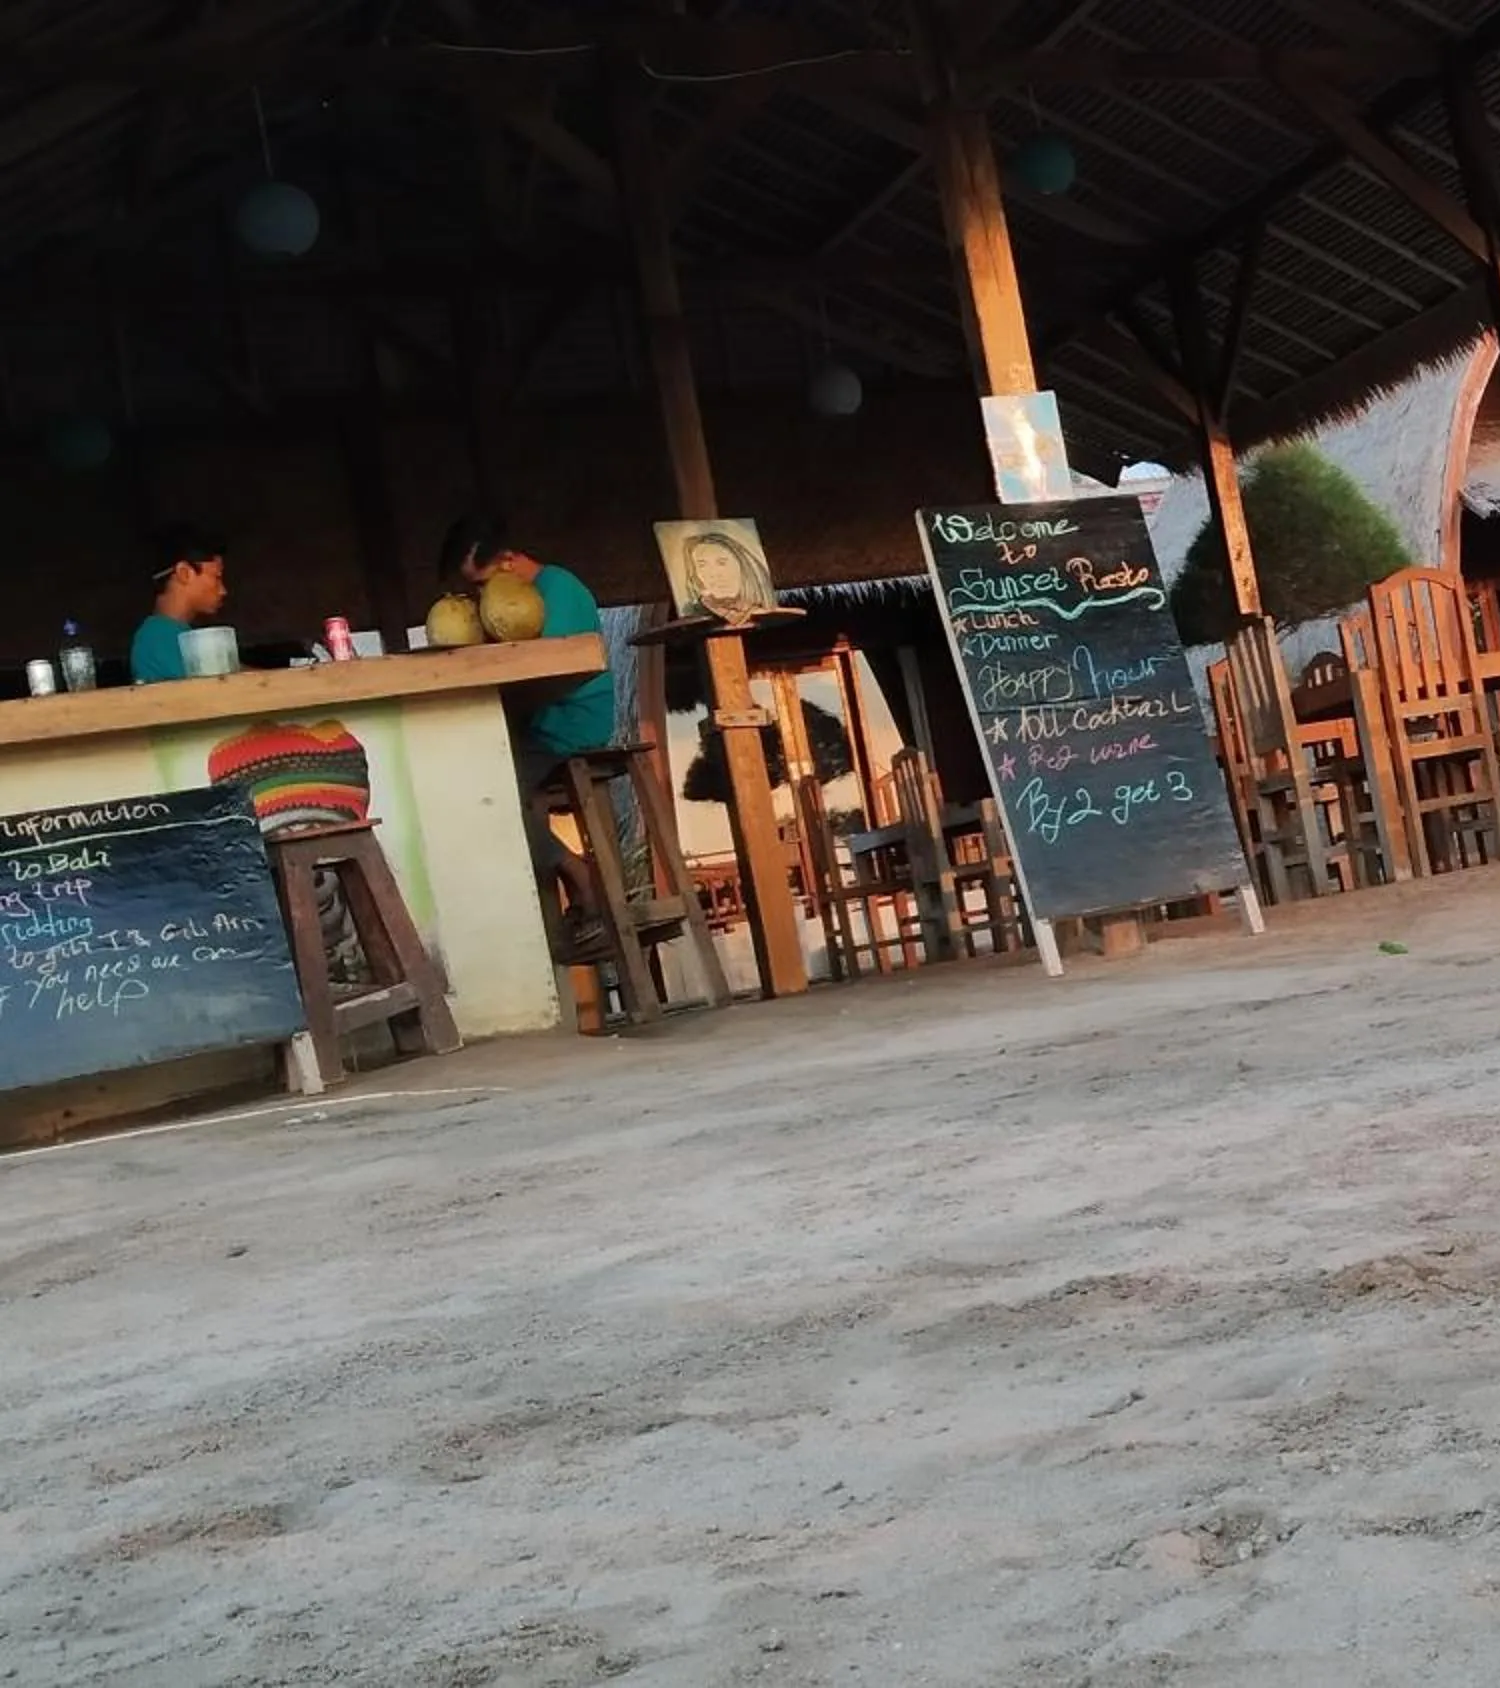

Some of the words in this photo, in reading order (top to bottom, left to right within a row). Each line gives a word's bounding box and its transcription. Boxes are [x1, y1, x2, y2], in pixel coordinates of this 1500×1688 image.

[932, 513, 1080, 543] Welcome
[998, 541, 1037, 564] to
[950, 566, 1068, 600] Sunset
[1111, 779, 1160, 825] get
[1166, 770, 1193, 801] 3
[56, 979, 149, 1019] help
